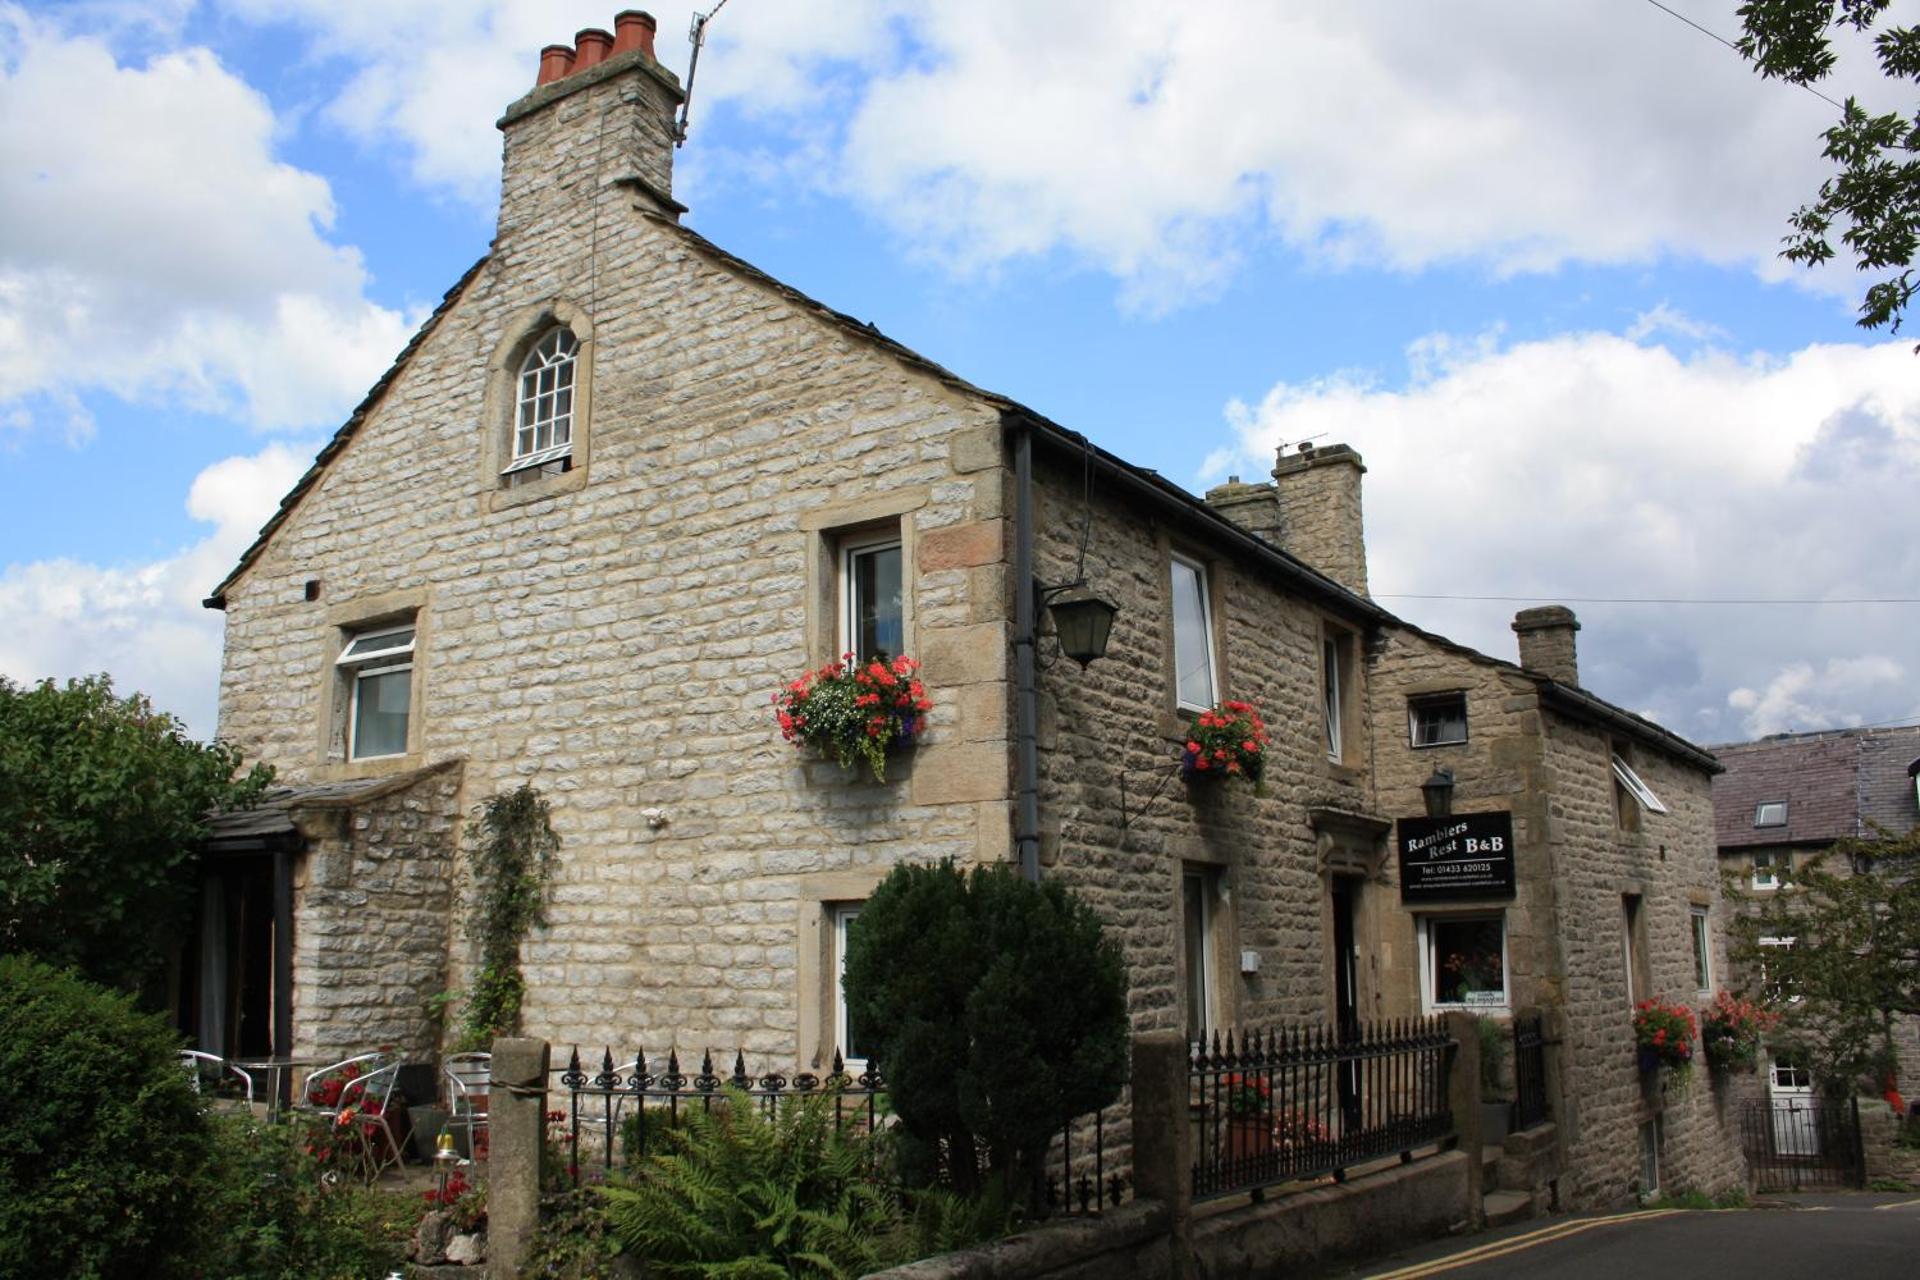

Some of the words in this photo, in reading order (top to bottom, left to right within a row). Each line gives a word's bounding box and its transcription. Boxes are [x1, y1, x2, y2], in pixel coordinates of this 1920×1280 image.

[1408, 822, 1468, 852] Ramblers
[1429, 839, 1457, 859] Rest
[1465, 836, 1504, 853] B&B
[1437, 864, 1460, 874] 01433
[1463, 863, 1491, 872] 620125
